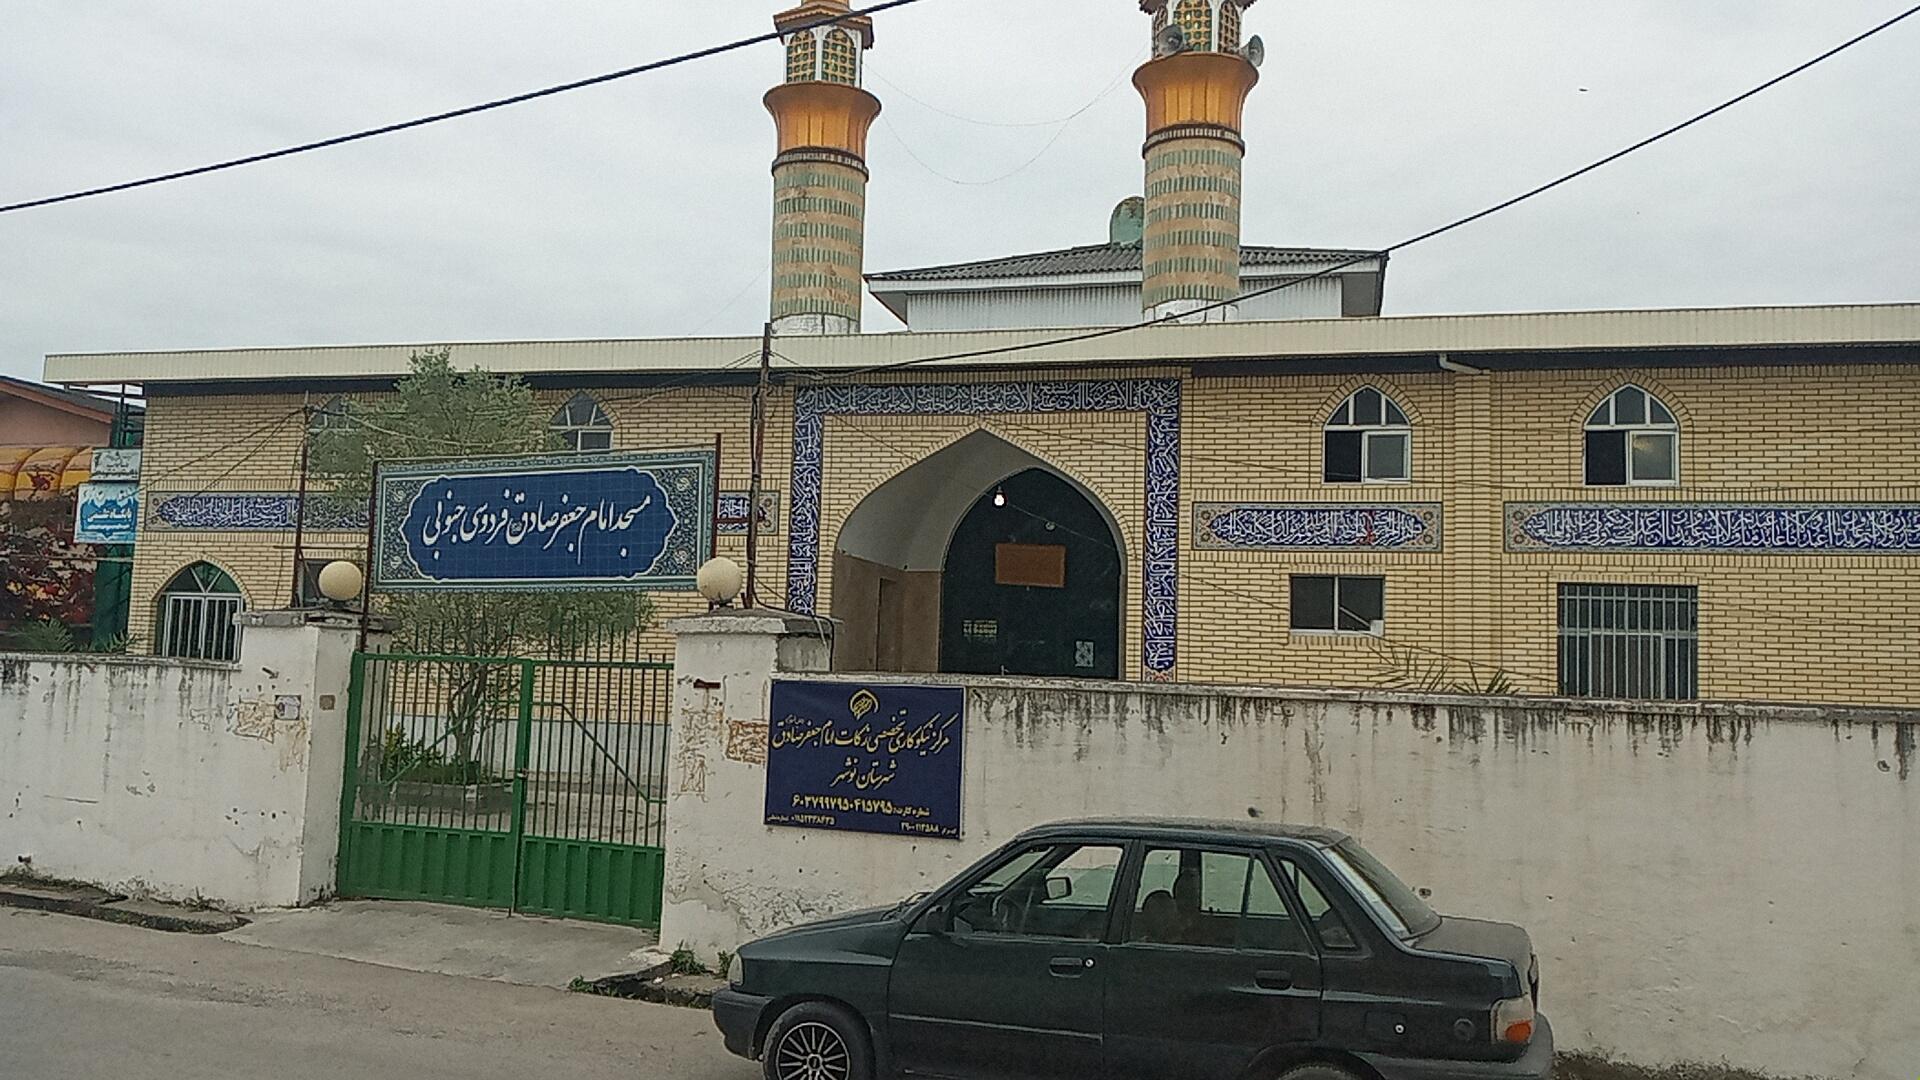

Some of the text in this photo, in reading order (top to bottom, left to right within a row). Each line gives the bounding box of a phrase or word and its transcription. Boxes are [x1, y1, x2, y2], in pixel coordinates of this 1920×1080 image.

[422, 490, 465, 560] جنوبی
[459, 488, 509, 545] فردوسی
[506, 493, 560, 545] صادق
[543, 494, 587, 551] جعفر
[577, 495, 614, 565] امام
[614, 495, 652, 558] مسجد
[772, 720, 803, 749] صادق
[796, 720, 823, 749] جعفر
[819, 719, 835, 748] امام
[835, 723, 872, 747] زکات
[929, 712, 960, 754] مرکز
[828, 756, 897, 791] شهرستان نوشهر
